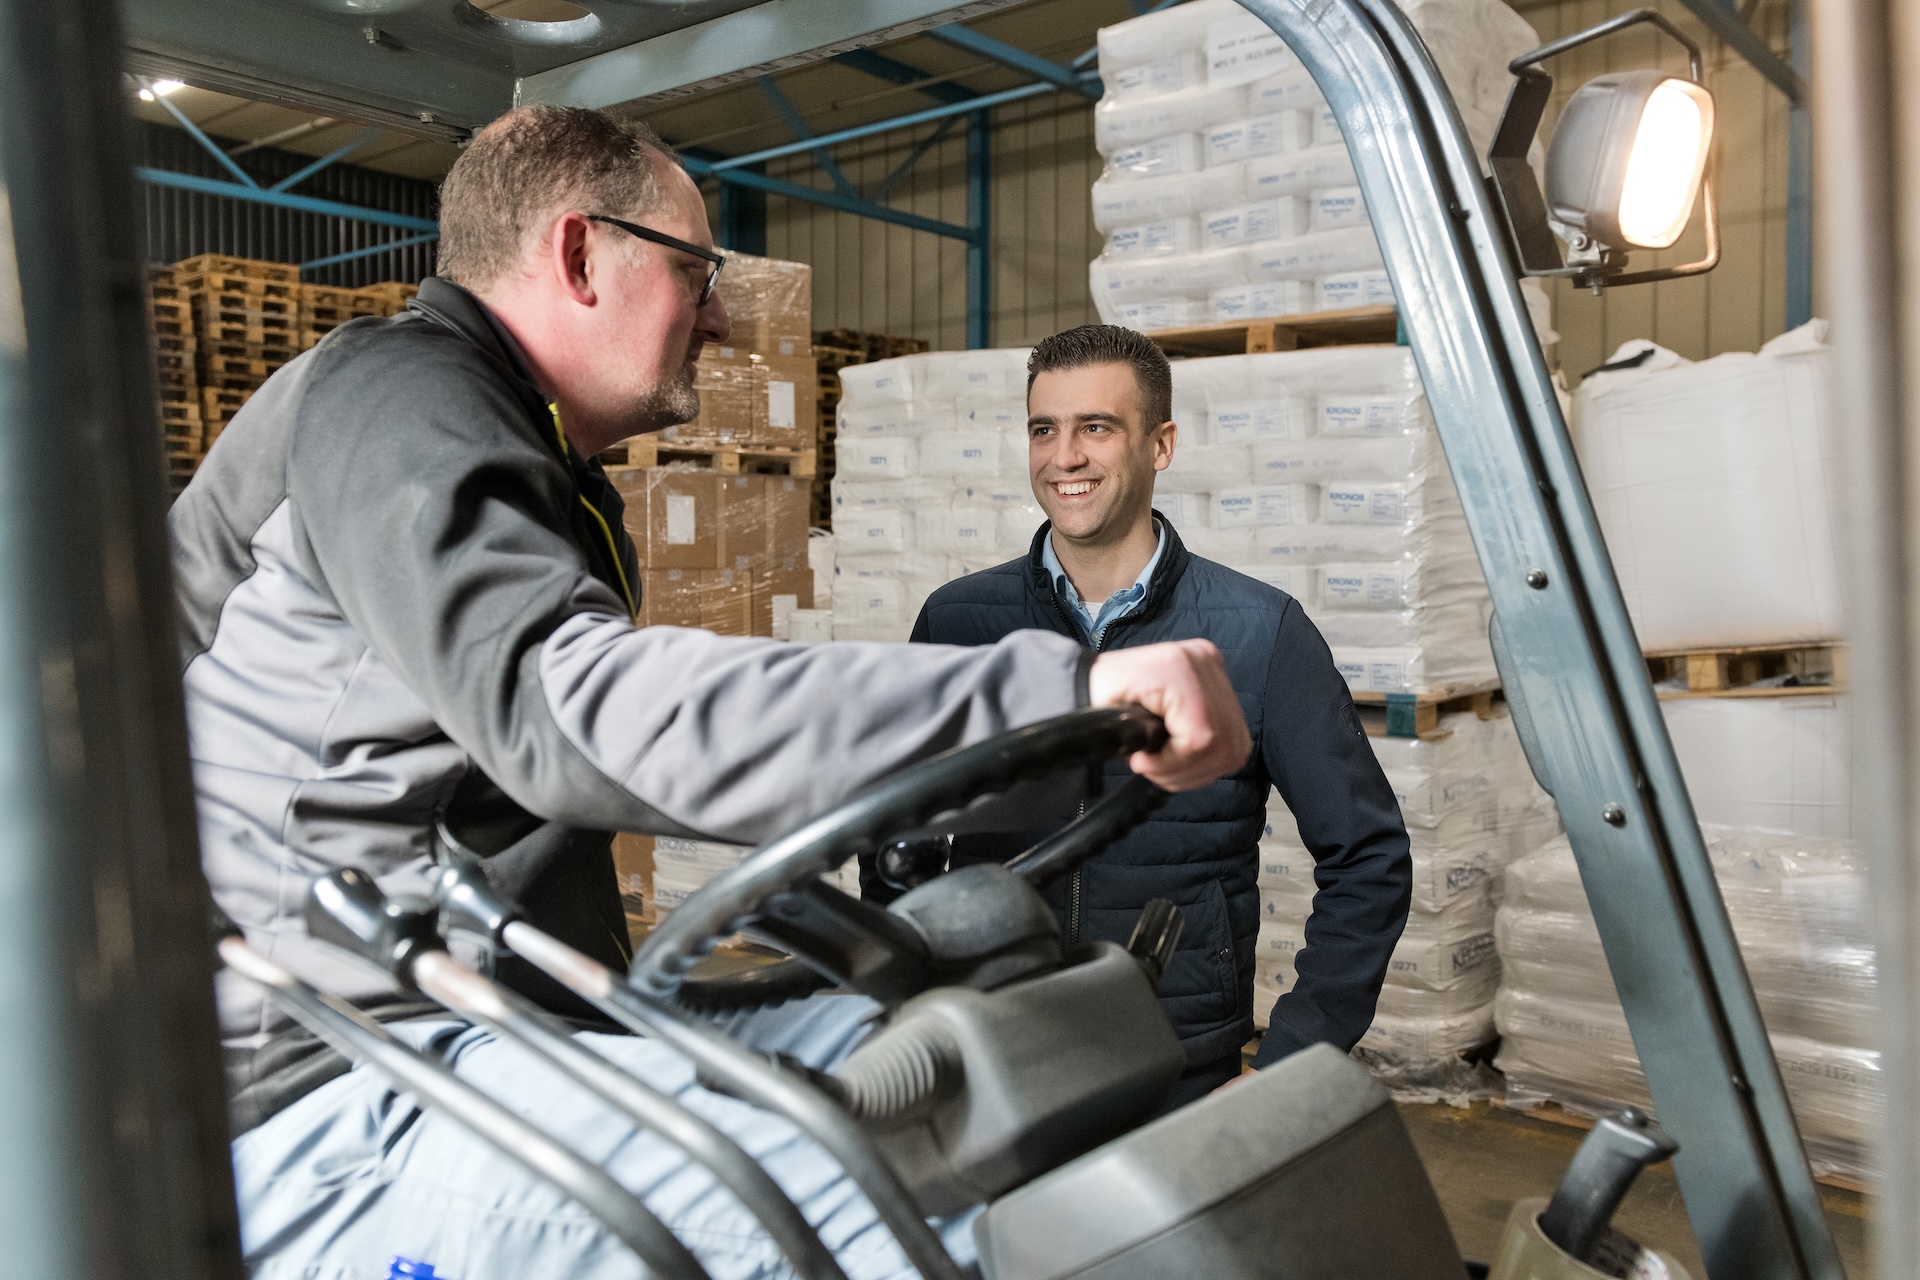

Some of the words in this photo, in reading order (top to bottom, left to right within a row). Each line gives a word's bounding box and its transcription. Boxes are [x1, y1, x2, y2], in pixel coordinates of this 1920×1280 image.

[1326, 406, 1361, 415] KRONOS
[1218, 413, 1250, 422] KRONOS
[963, 449, 982, 458] 0271
[870, 456, 887, 465] 0271
[1330, 492, 1365, 501] KRONOS
[1221, 497, 1252, 506] KRONOS
[868, 528, 884, 537] 0271
[1327, 577, 1363, 586] KRONOS
[1266, 864, 1289, 875] 0271
[1271, 939, 1295, 951] 0271
[1392, 961, 1417, 972] 0271
